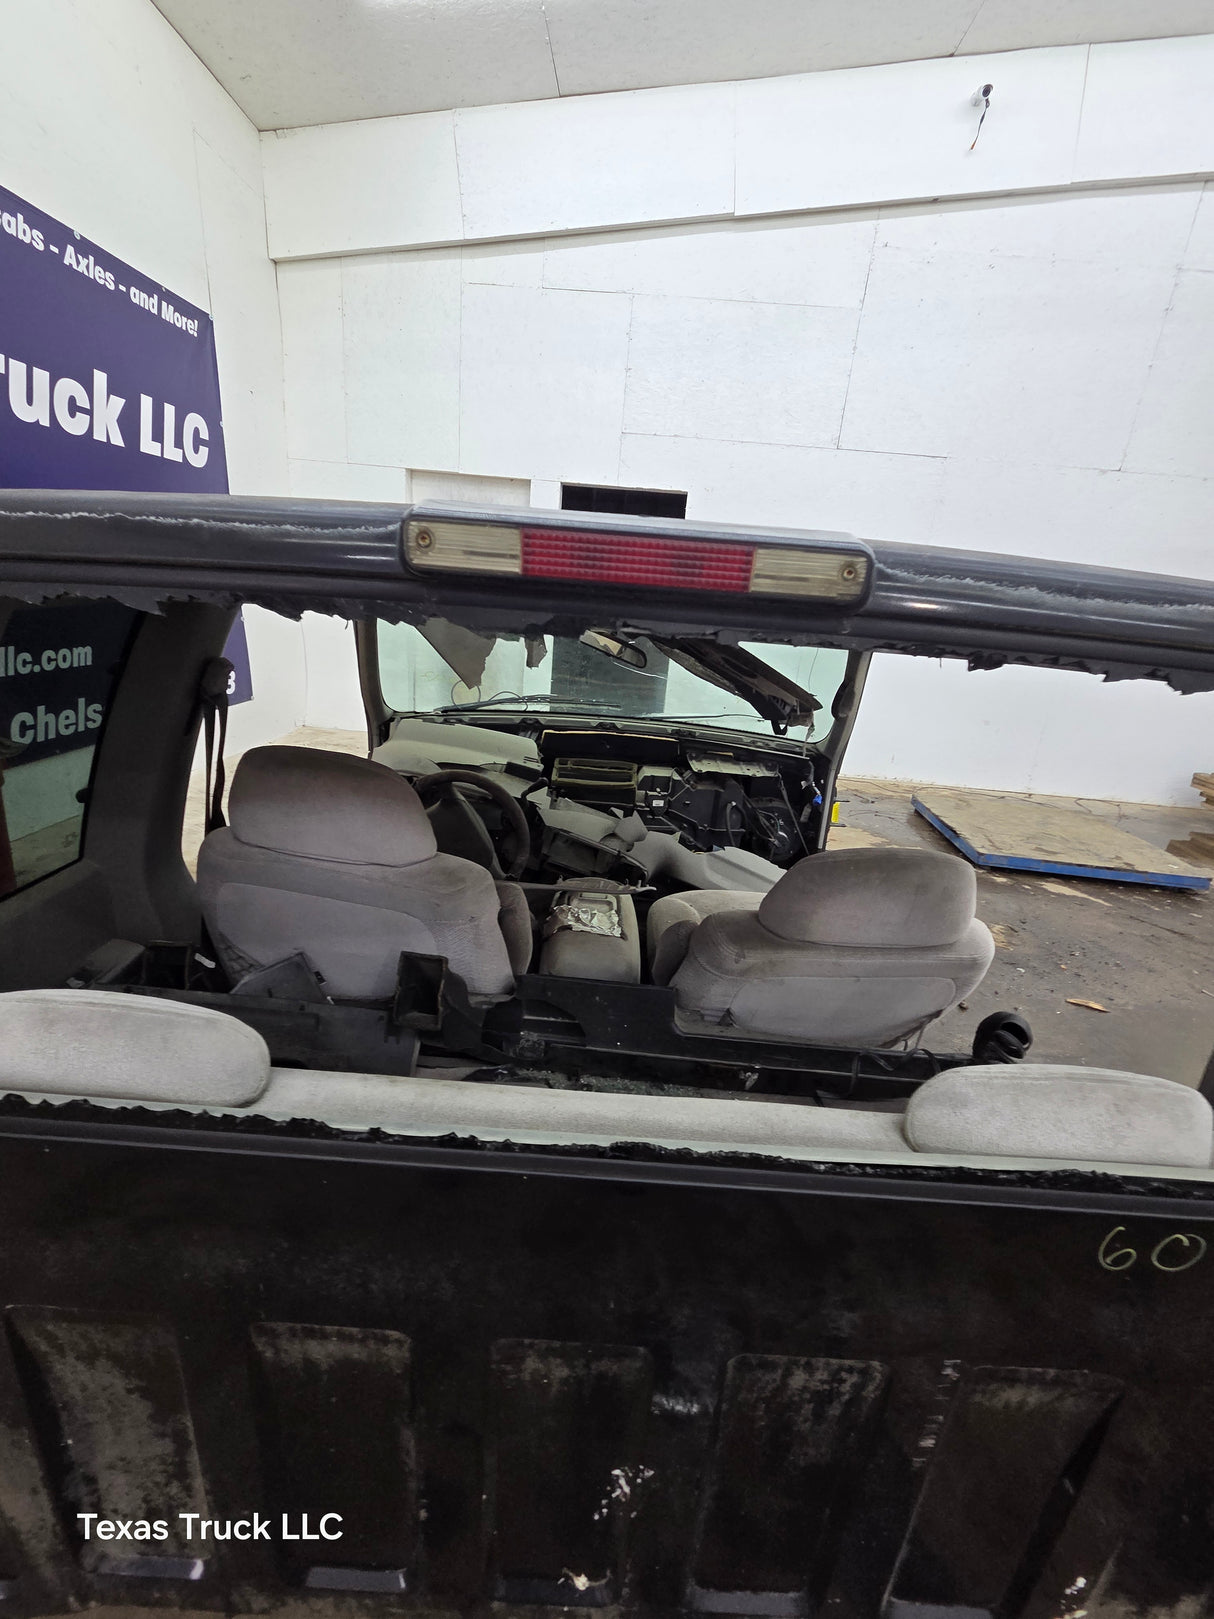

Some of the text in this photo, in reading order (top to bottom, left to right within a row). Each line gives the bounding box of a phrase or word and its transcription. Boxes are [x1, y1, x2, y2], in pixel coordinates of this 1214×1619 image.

[0, 210, 45, 251] abs
[63, 244, 115, 290] Axles
[129, 286, 158, 315] and
[161, 300, 199, 337] More!
[139, 393, 210, 468] LLC
[10, 697, 103, 745] Chels
[1098, 1226, 1207, 1272] 60
